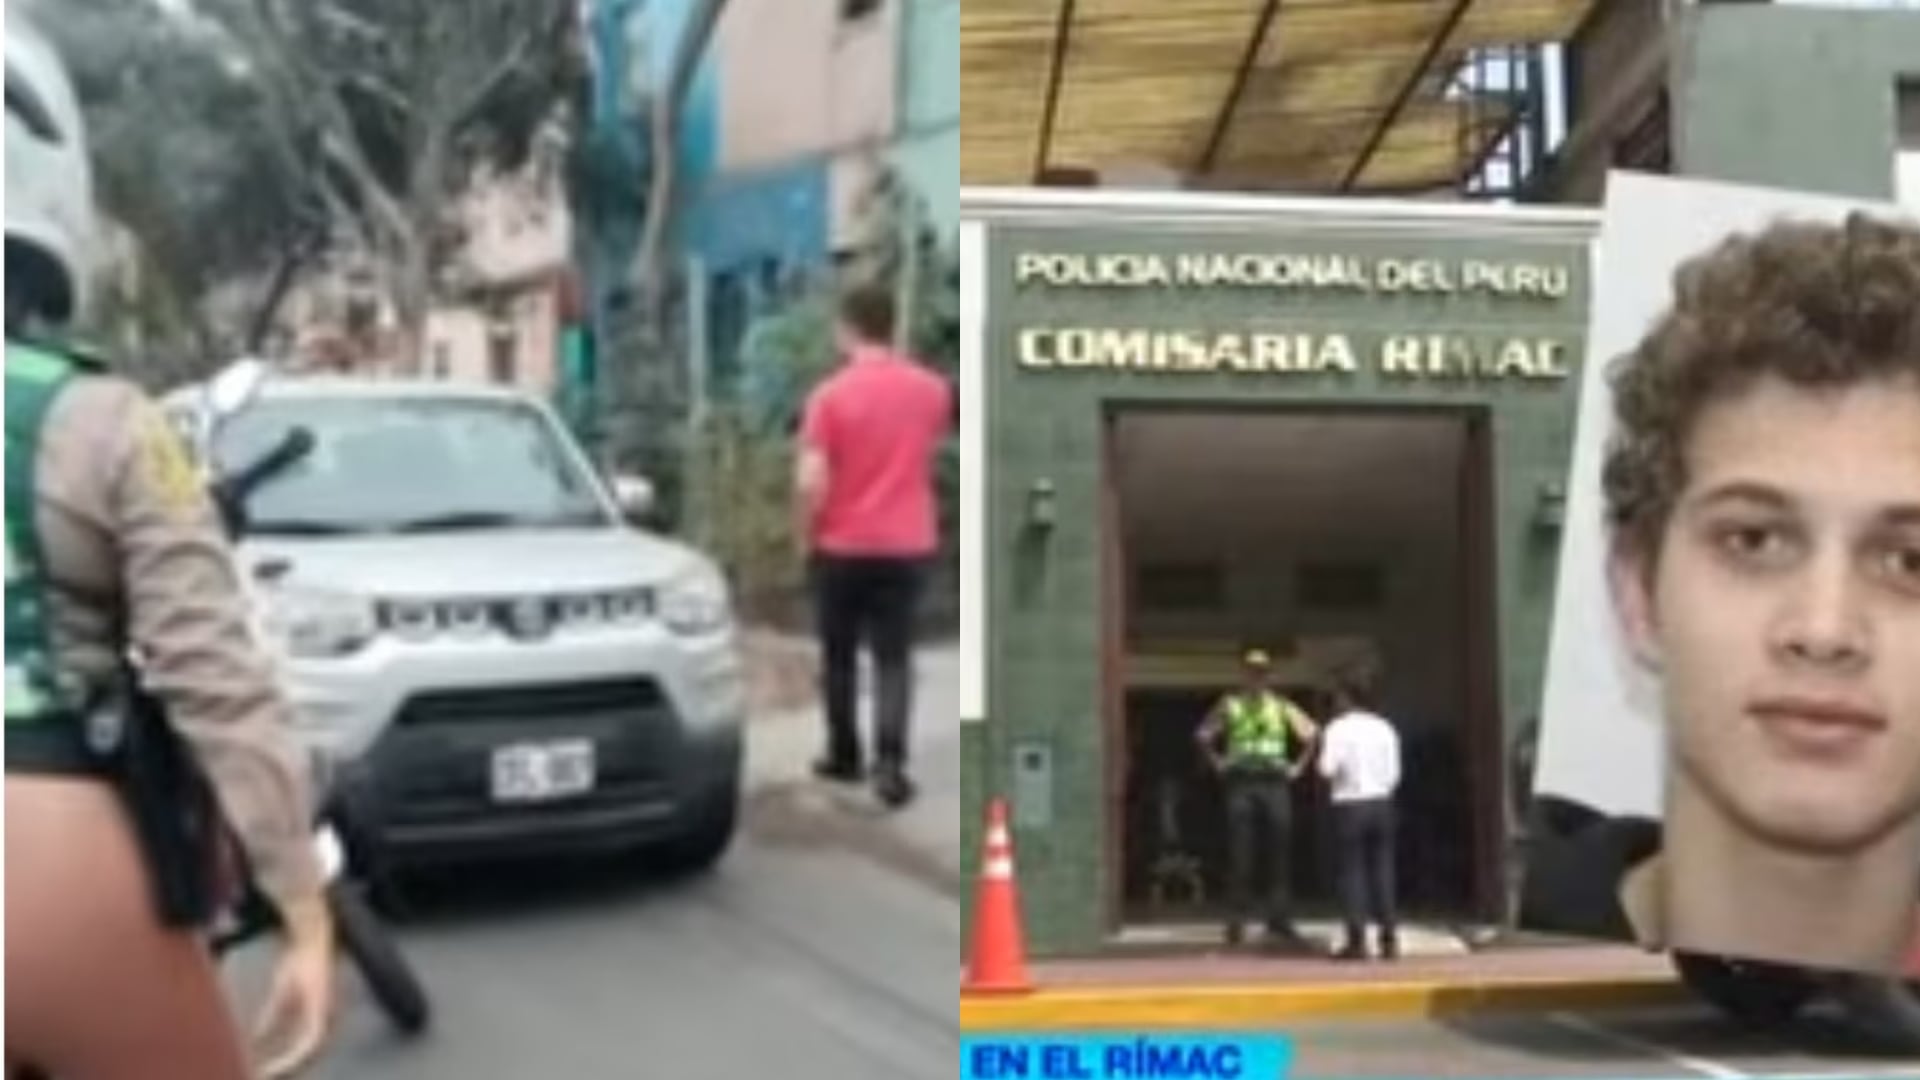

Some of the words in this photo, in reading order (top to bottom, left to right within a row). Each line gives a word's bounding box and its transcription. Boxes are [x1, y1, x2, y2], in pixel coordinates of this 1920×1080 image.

[1016, 252, 1169, 287] POLICIA
[1176, 253, 1370, 290] NACIONAL
[1376, 257, 1453, 292] DEL
[1018, 327, 1357, 372] COMISARIA
